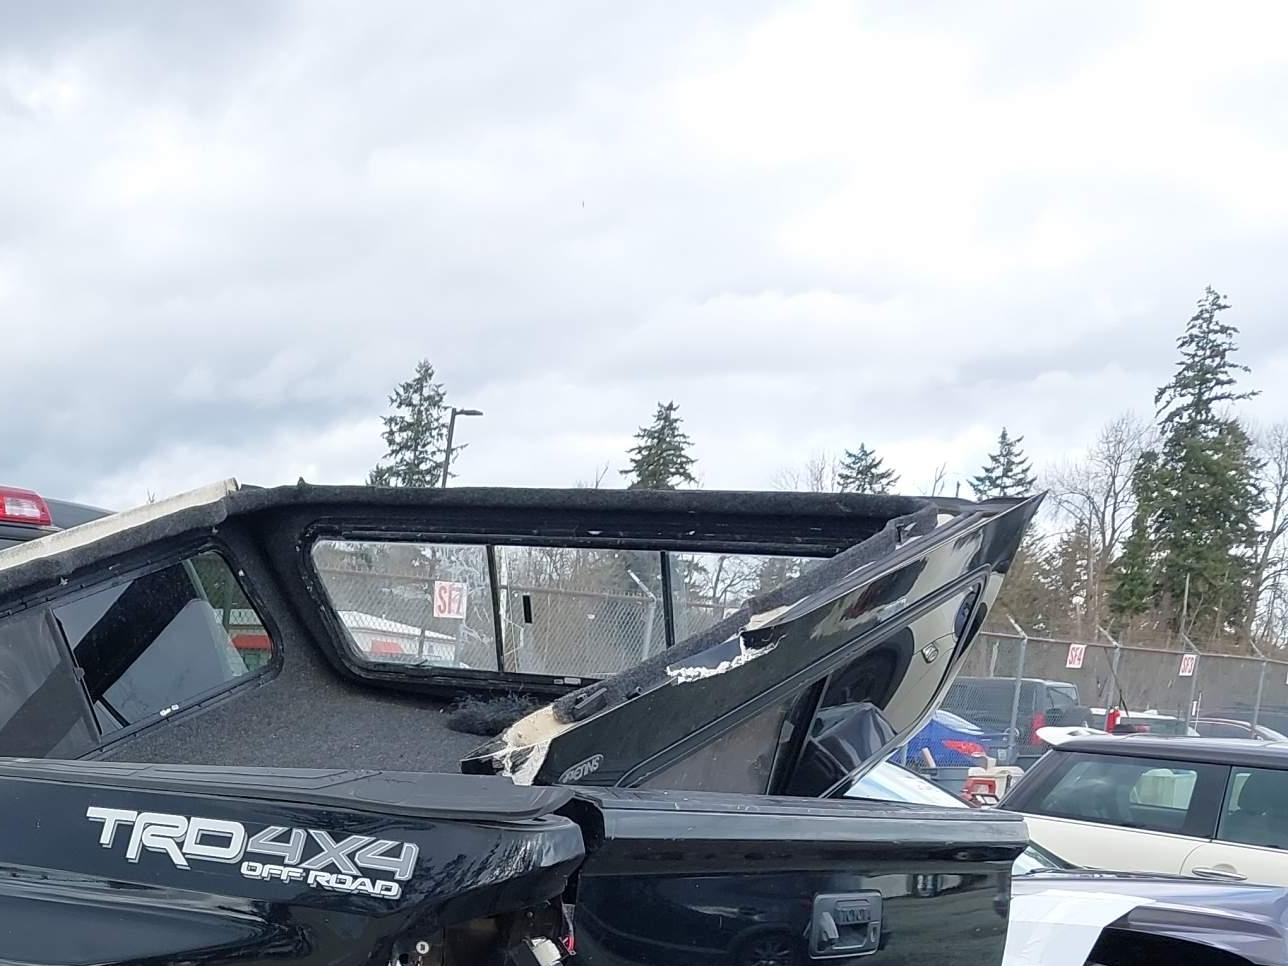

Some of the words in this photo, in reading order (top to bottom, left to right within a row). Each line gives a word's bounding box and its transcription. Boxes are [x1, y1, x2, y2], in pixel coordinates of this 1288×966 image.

[86, 806, 249, 870] TRD
[240, 861, 305, 884] OFF
[307, 871, 402, 900] ROAD
